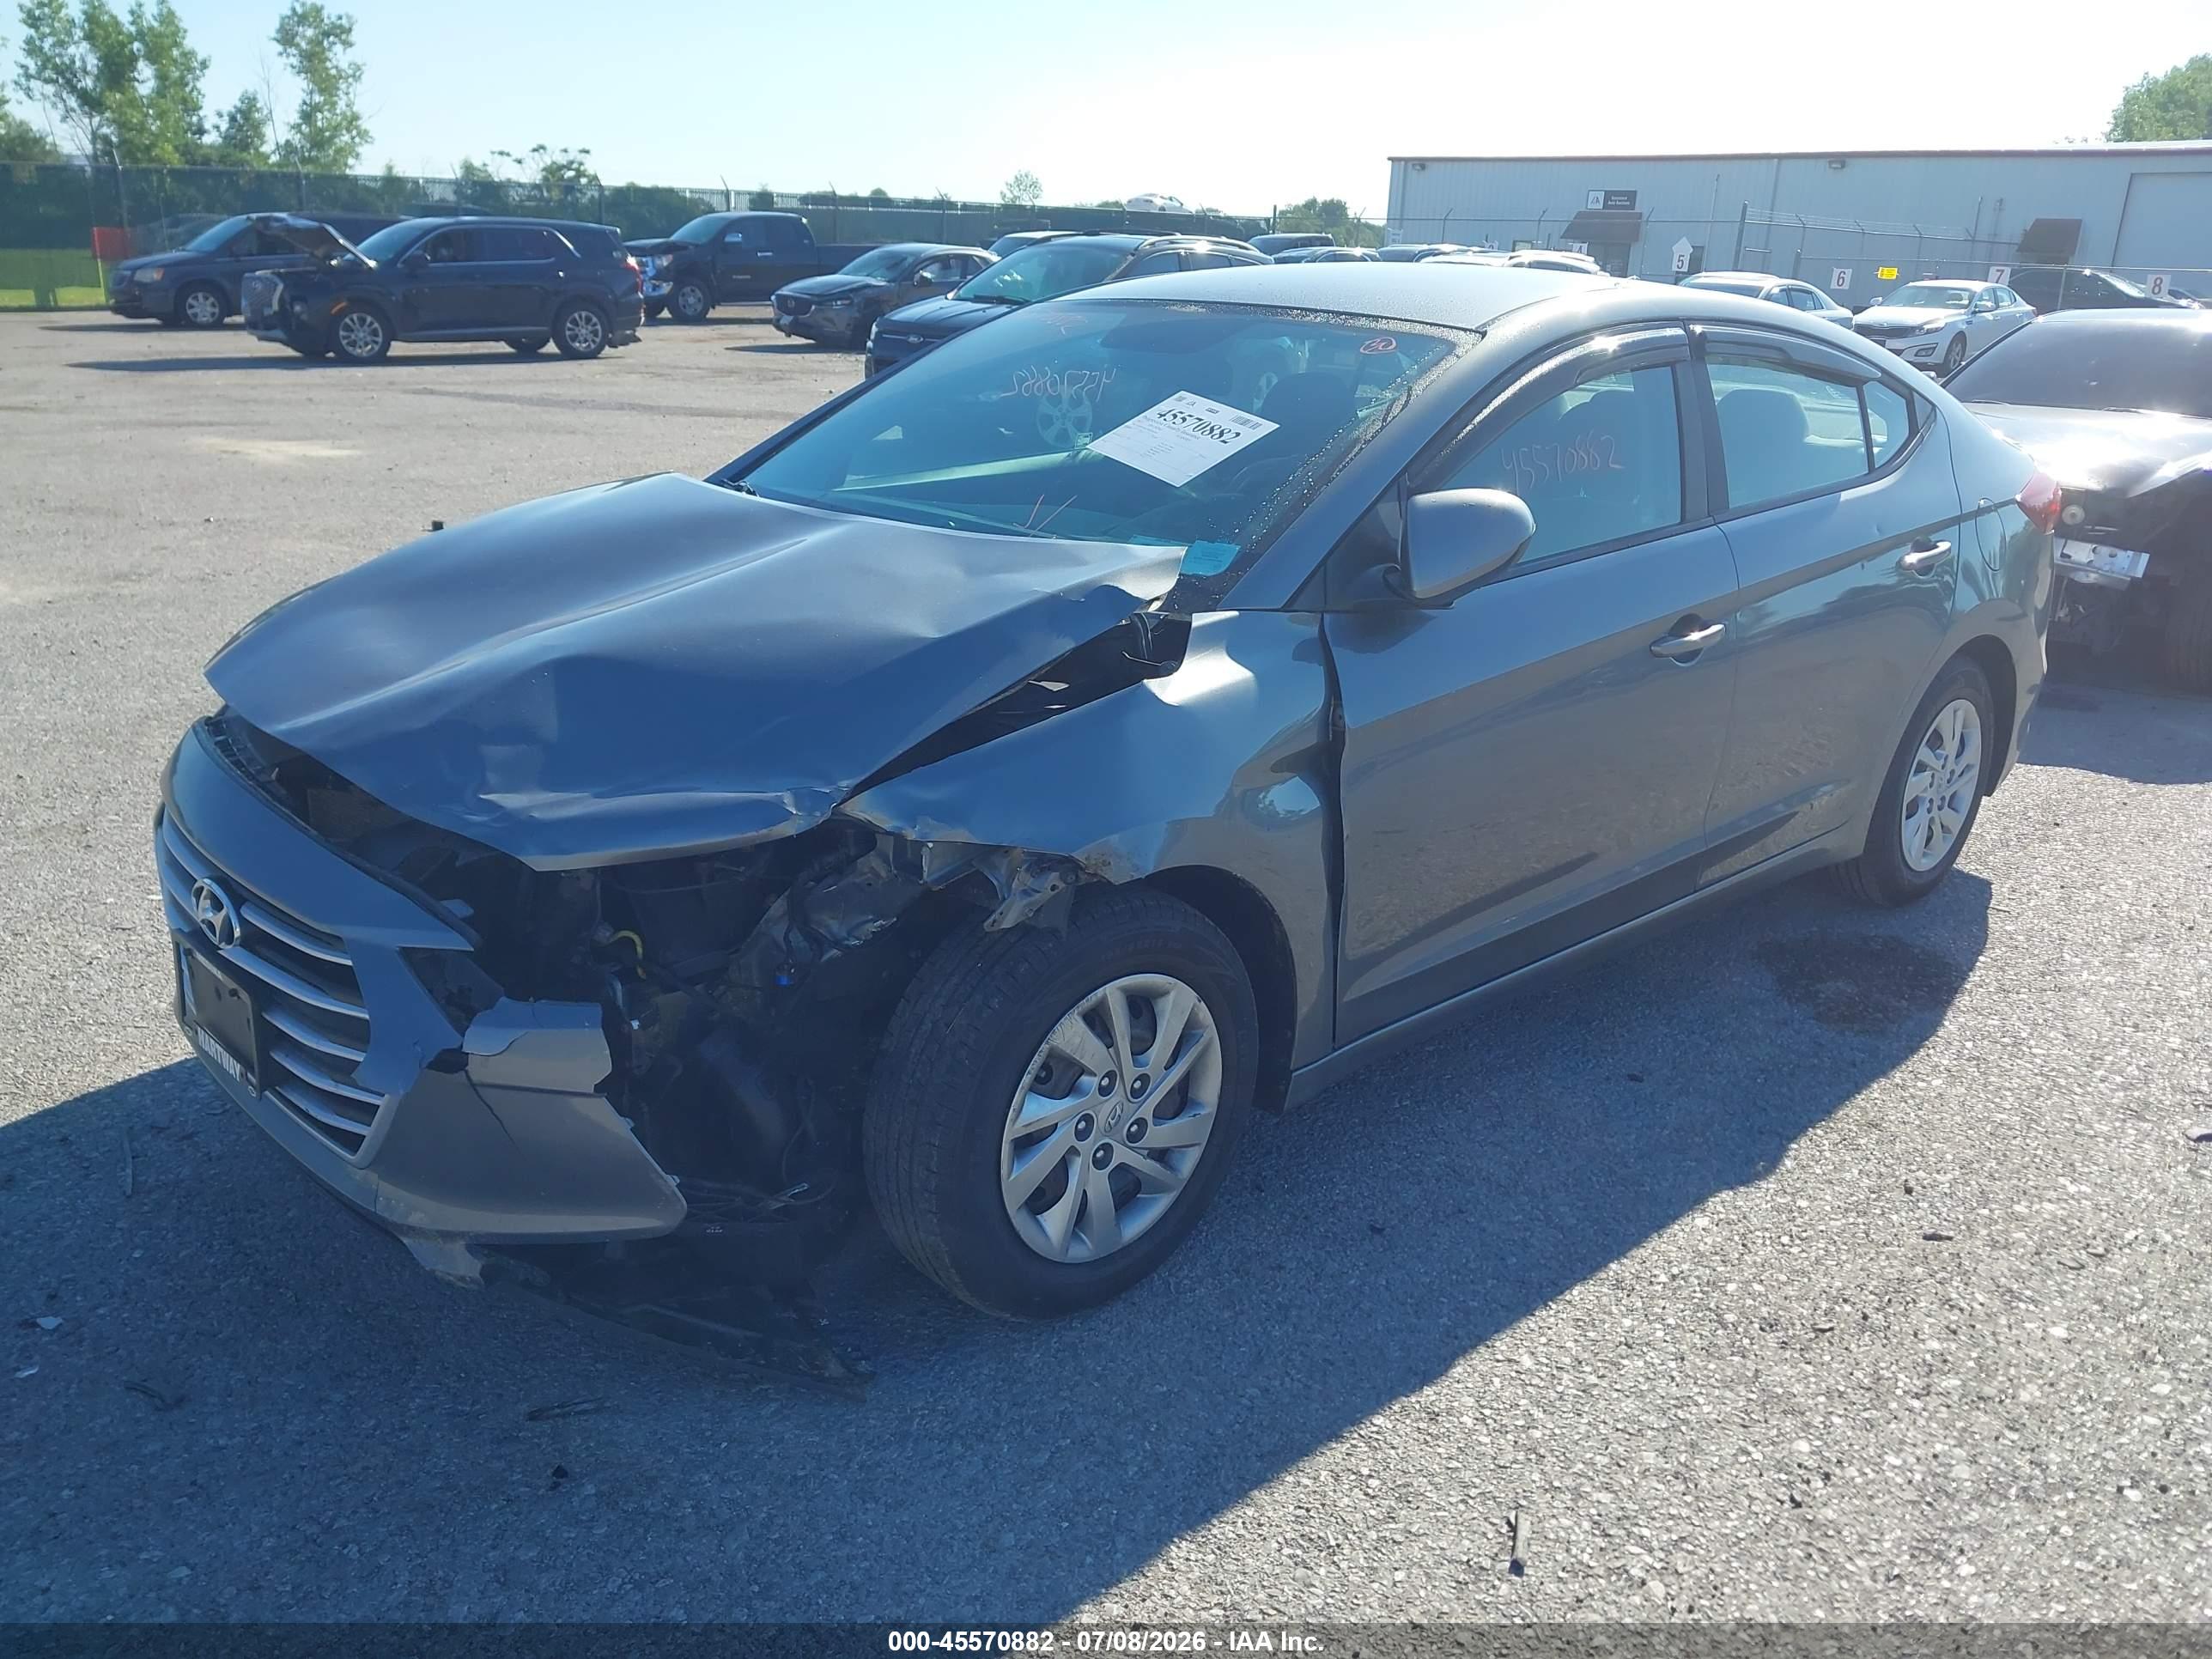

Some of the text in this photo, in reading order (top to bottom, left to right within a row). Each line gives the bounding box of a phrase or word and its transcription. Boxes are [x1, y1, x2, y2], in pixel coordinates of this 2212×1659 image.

[1676, 254, 1685, 269] 5
[1837, 270, 1846, 287] 6
[1996, 269, 2005, 283] 7
[2152, 276, 2164, 295] 8
[1157, 408, 1242, 444] 45570882
[198, 1026, 241, 1081] HARTWAY
